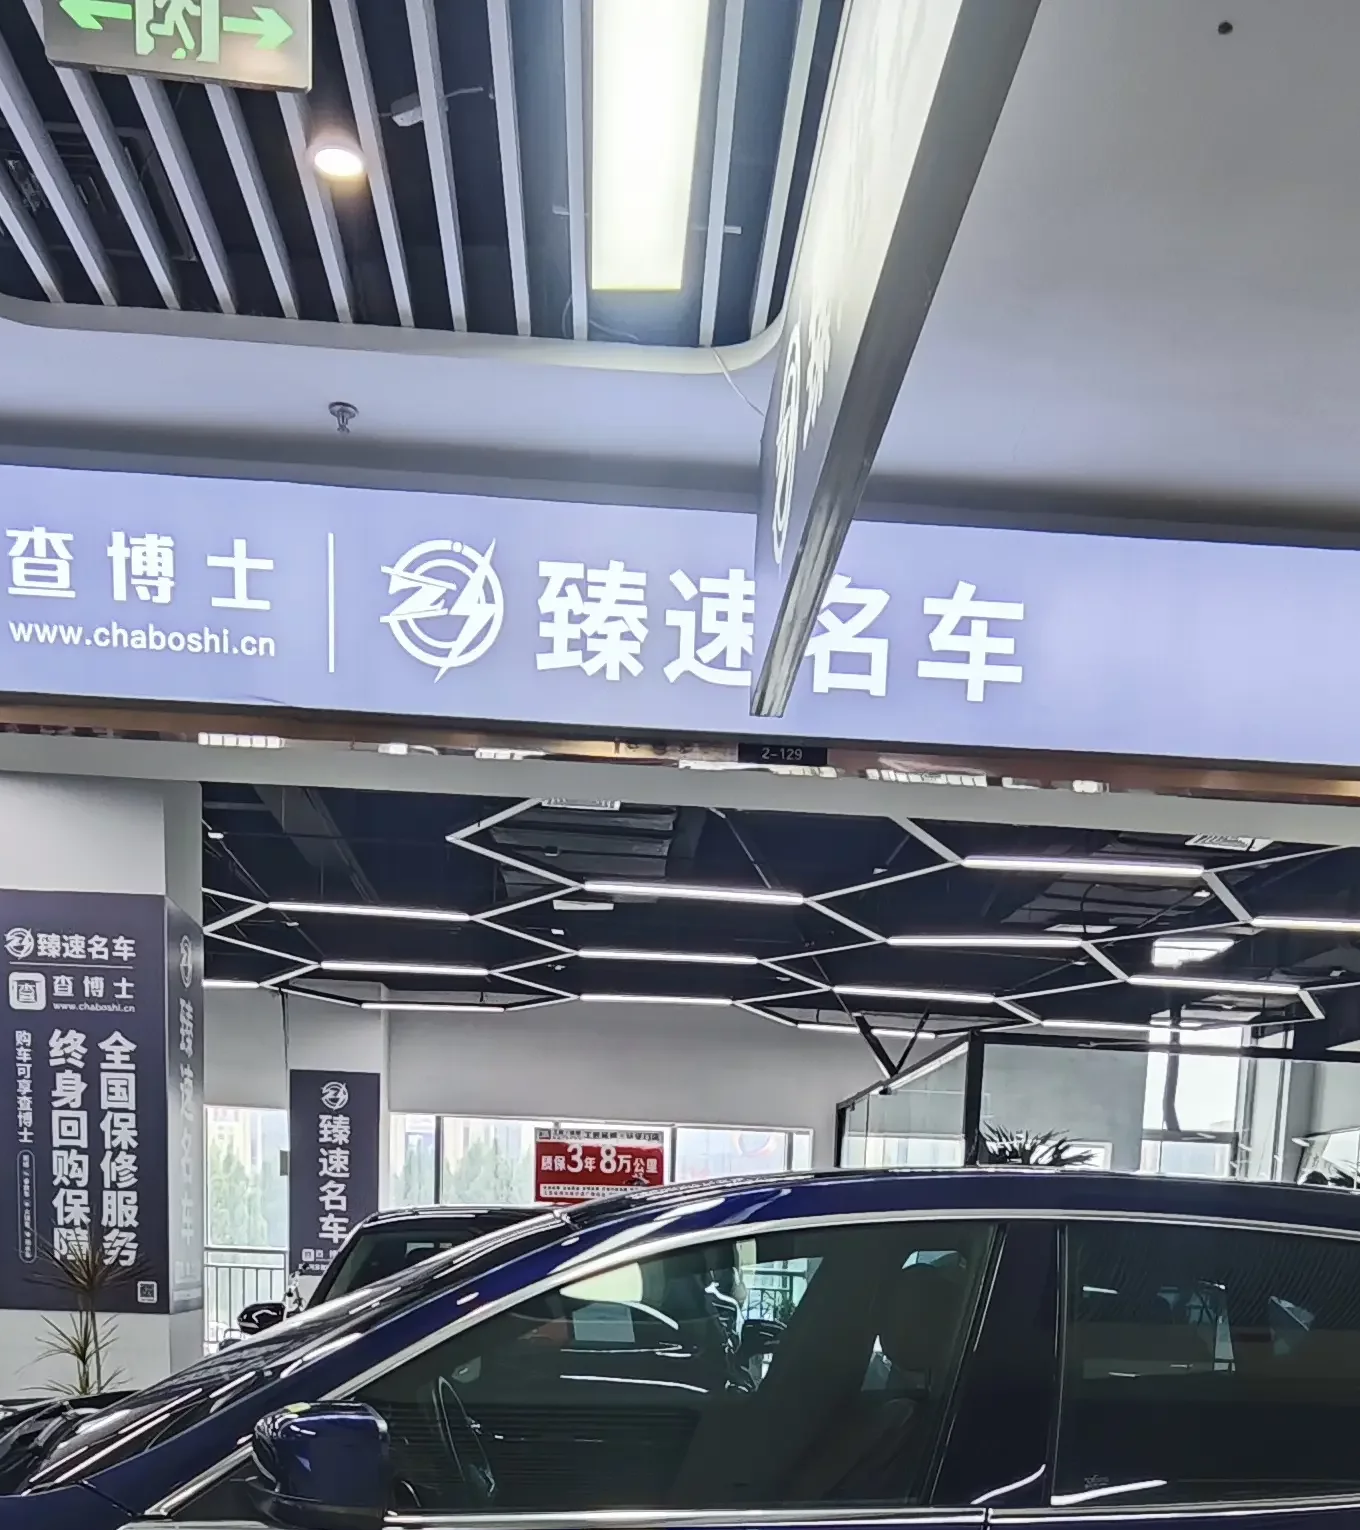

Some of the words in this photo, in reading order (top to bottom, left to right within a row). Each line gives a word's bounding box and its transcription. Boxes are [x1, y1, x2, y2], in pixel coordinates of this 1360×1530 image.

[6, 526, 274, 610] 查博士
[9, 621, 275, 656] www.chaboshi.cn
[536, 559, 1026, 703] 臻速名车
[762, 747, 803, 761] 2-129
[37, 933, 136, 961] 臻速名车
[52, 975, 135, 999] 查博士
[52, 1002, 136, 1013] www.chaboshi.cn
[48, 1028, 91, 1262] 终身回购保障
[98, 1031, 139, 1267] 全国保修服务
[318, 1114, 351, 1244] 臻速名车
